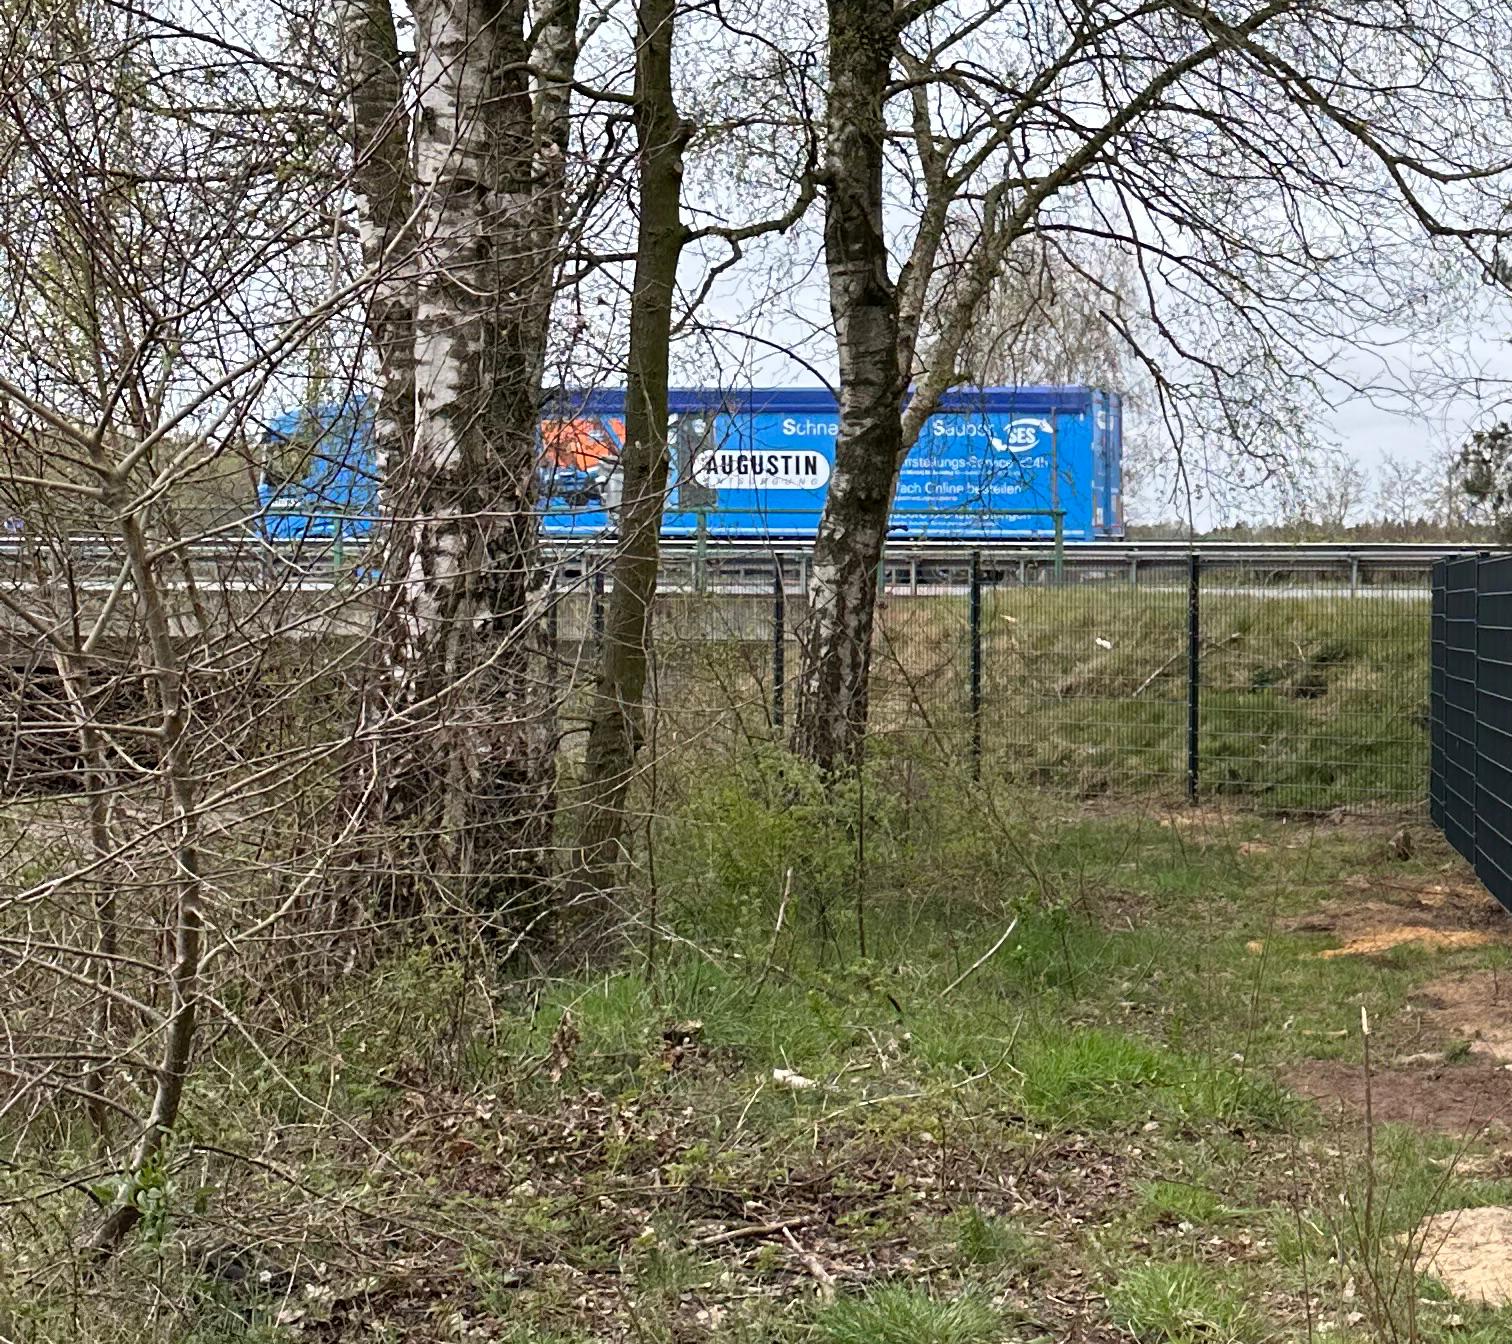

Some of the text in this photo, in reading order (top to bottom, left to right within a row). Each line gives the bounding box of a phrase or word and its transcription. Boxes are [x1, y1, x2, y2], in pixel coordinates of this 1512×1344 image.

[783, 418, 838, 435] Schne
[1008, 427, 1036, 444] SES
[706, 454, 818, 476] AUGUSTIN
